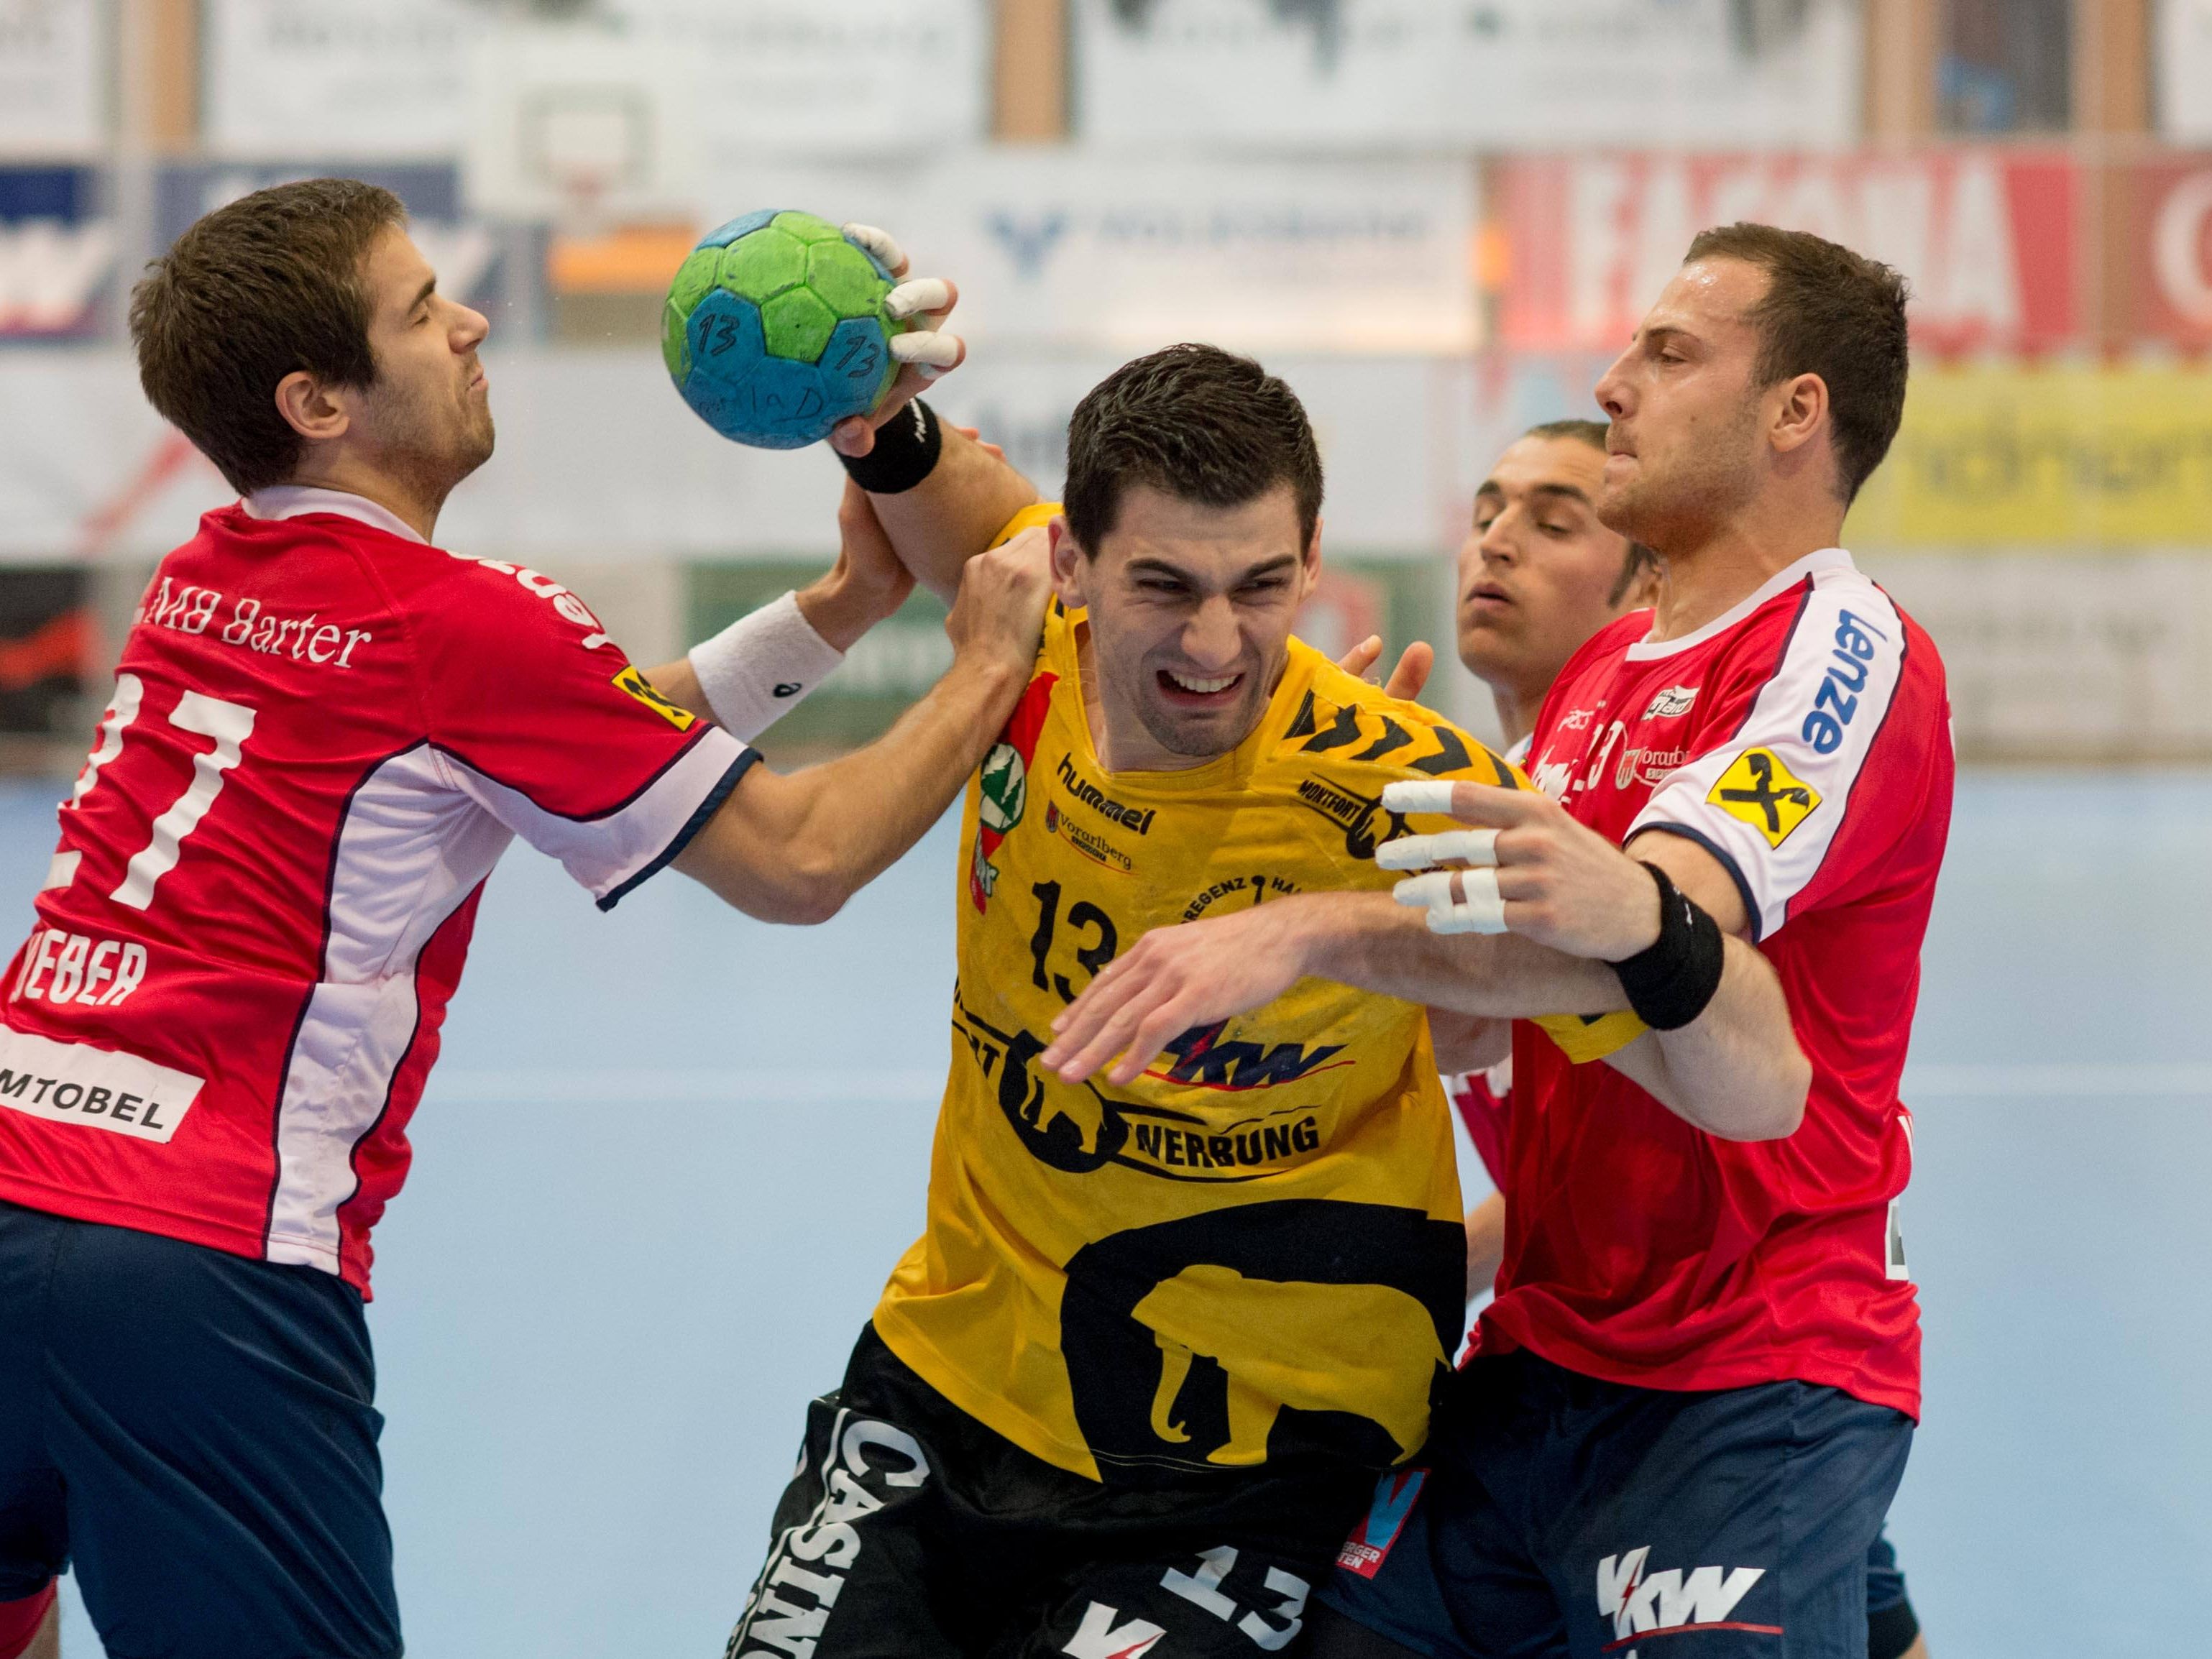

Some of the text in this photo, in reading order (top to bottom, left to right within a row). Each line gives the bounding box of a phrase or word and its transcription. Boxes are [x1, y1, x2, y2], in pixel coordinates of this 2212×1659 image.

[698, 313, 740, 357] 13
[835, 335, 881, 378] 13
[1802, 609, 1888, 755] Lenze
[1057, 752, 1157, 836] hummel
[1297, 778, 1362, 822] MONTFORT
[1059, 812, 1132, 870] Vorarlberg
[1030, 880, 1118, 1005] 13
[1181, 877, 1247, 924] REGENZ
[740, 1420, 932, 1659] CASIN
[1159, 1545, 1311, 1651] 13
[1597, 1545, 1766, 1641] VKW
